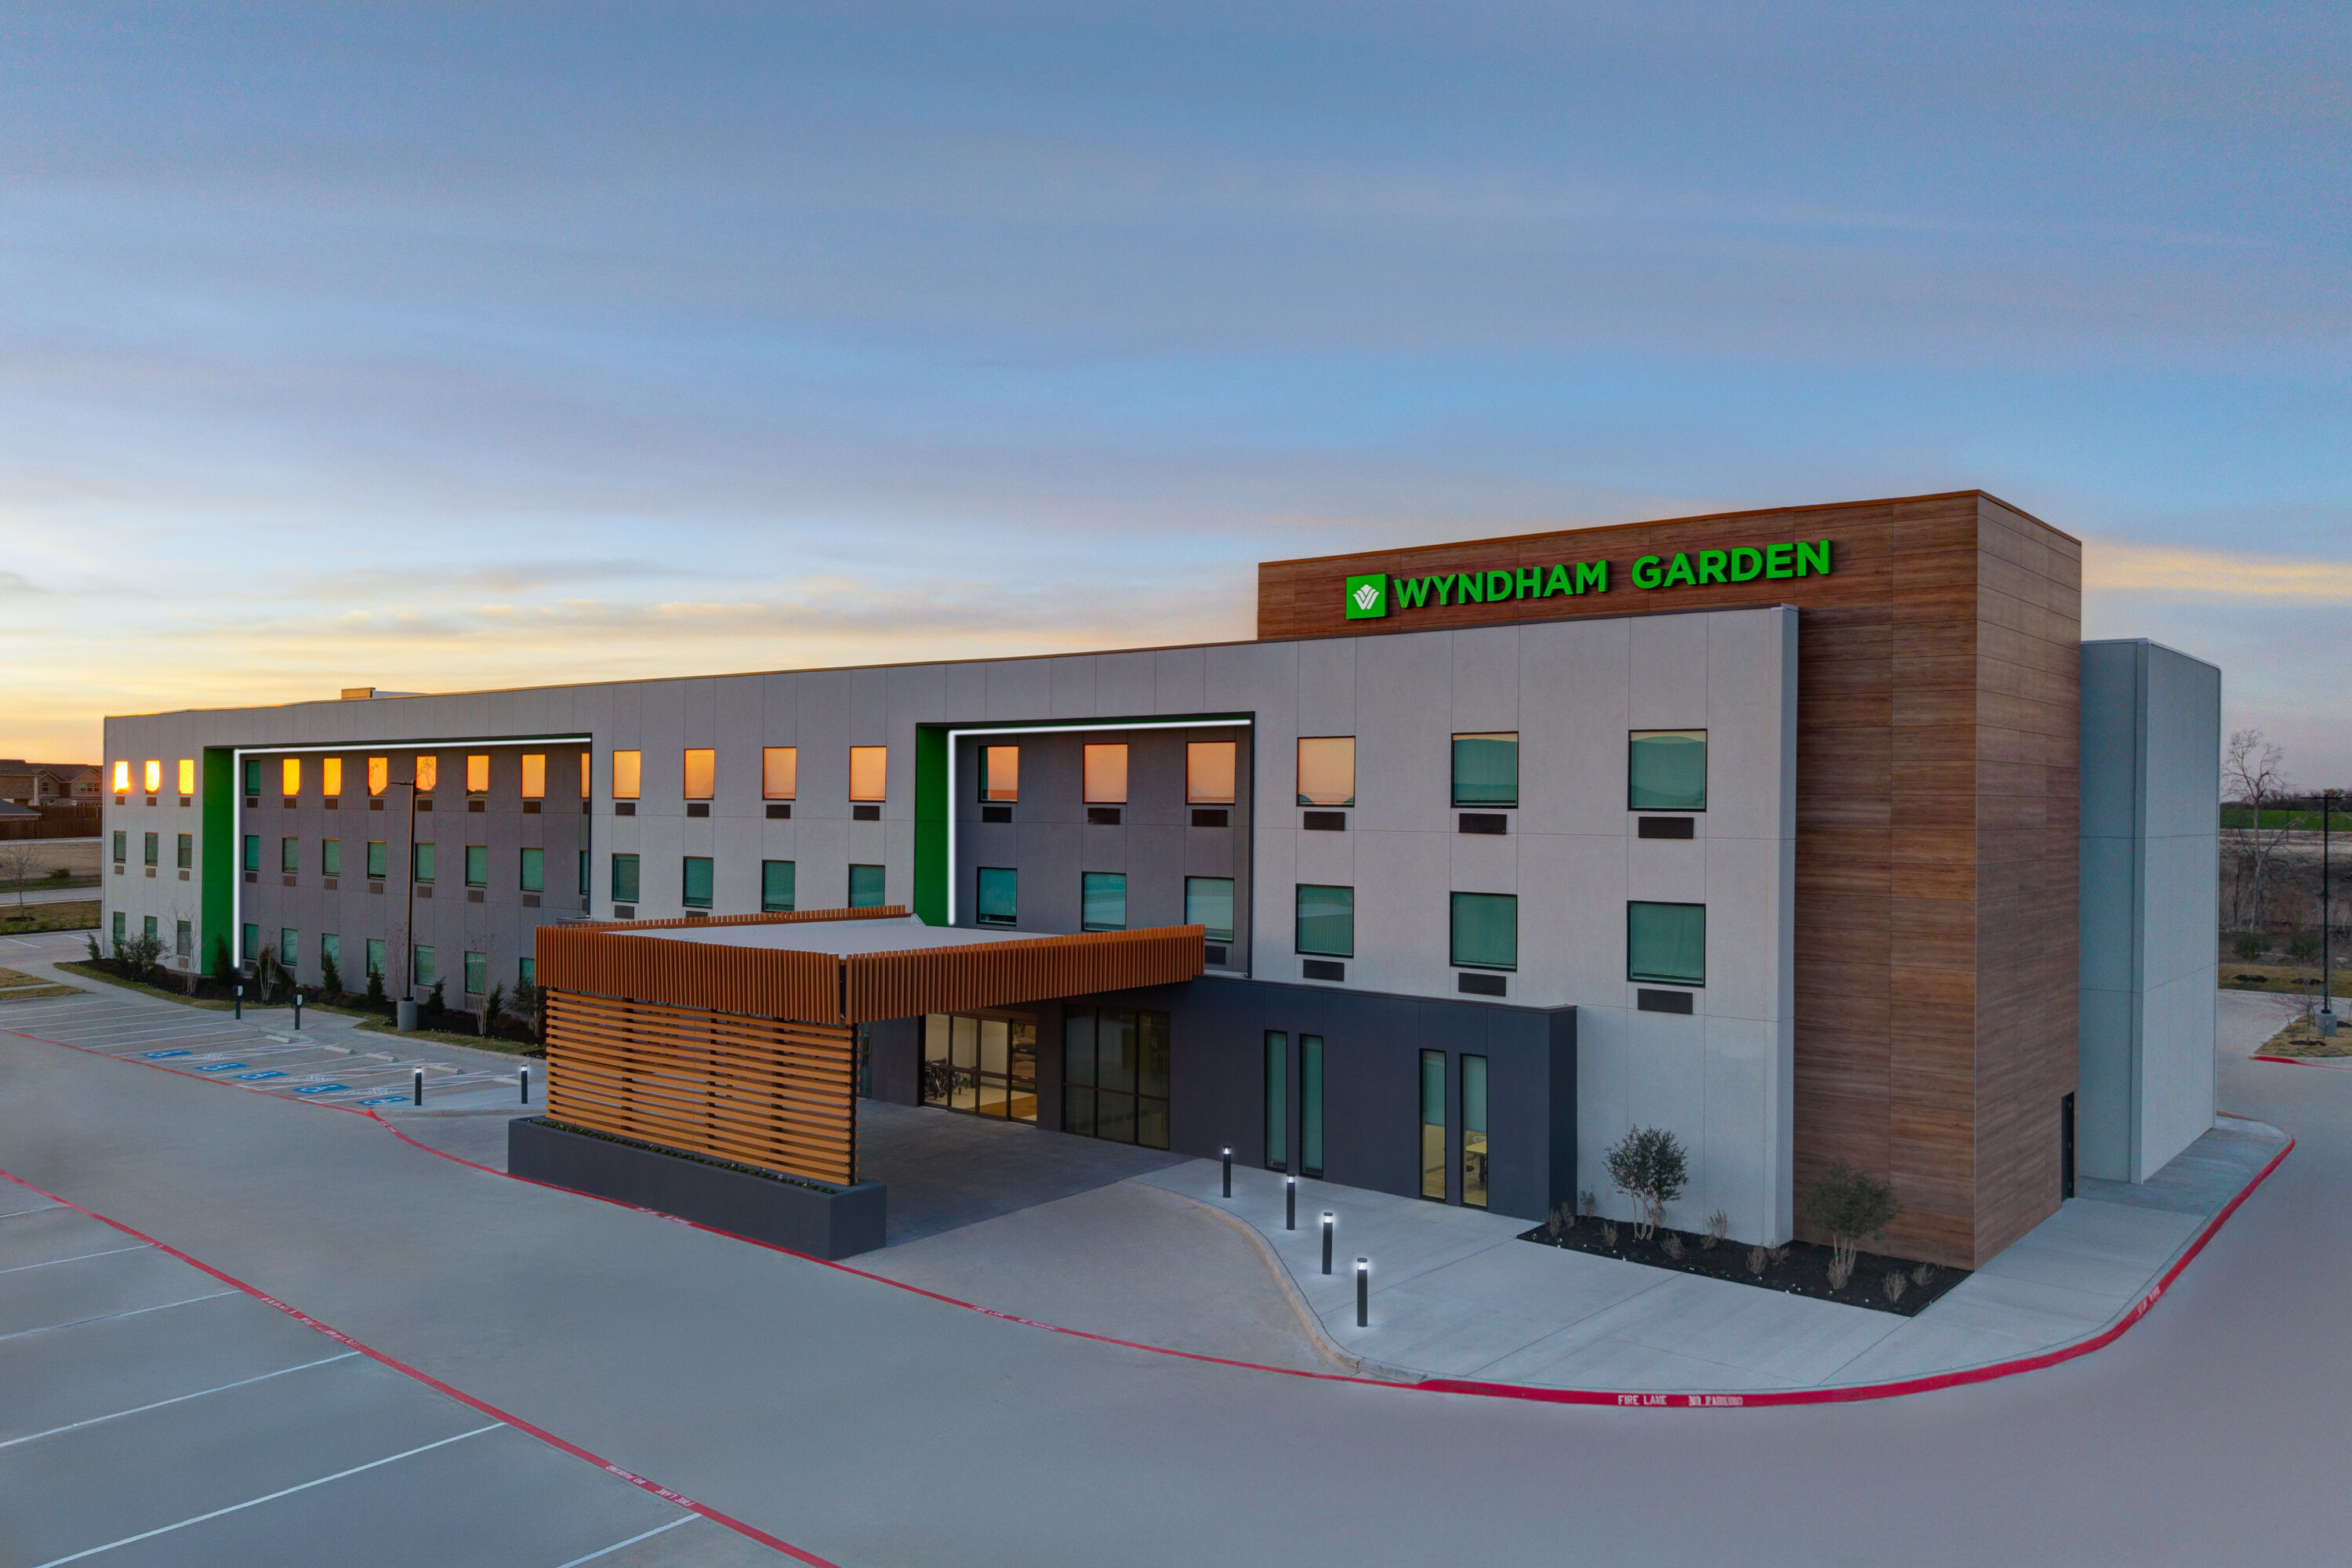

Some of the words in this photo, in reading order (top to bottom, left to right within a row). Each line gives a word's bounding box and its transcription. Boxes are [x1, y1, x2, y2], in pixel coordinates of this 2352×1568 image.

[1394, 560, 1608, 608] WYNDHAM
[1632, 539, 1831, 590] GARDEN
[1618, 1395, 1639, 1406] FIRE
[1643, 1395, 1667, 1406] LANE
